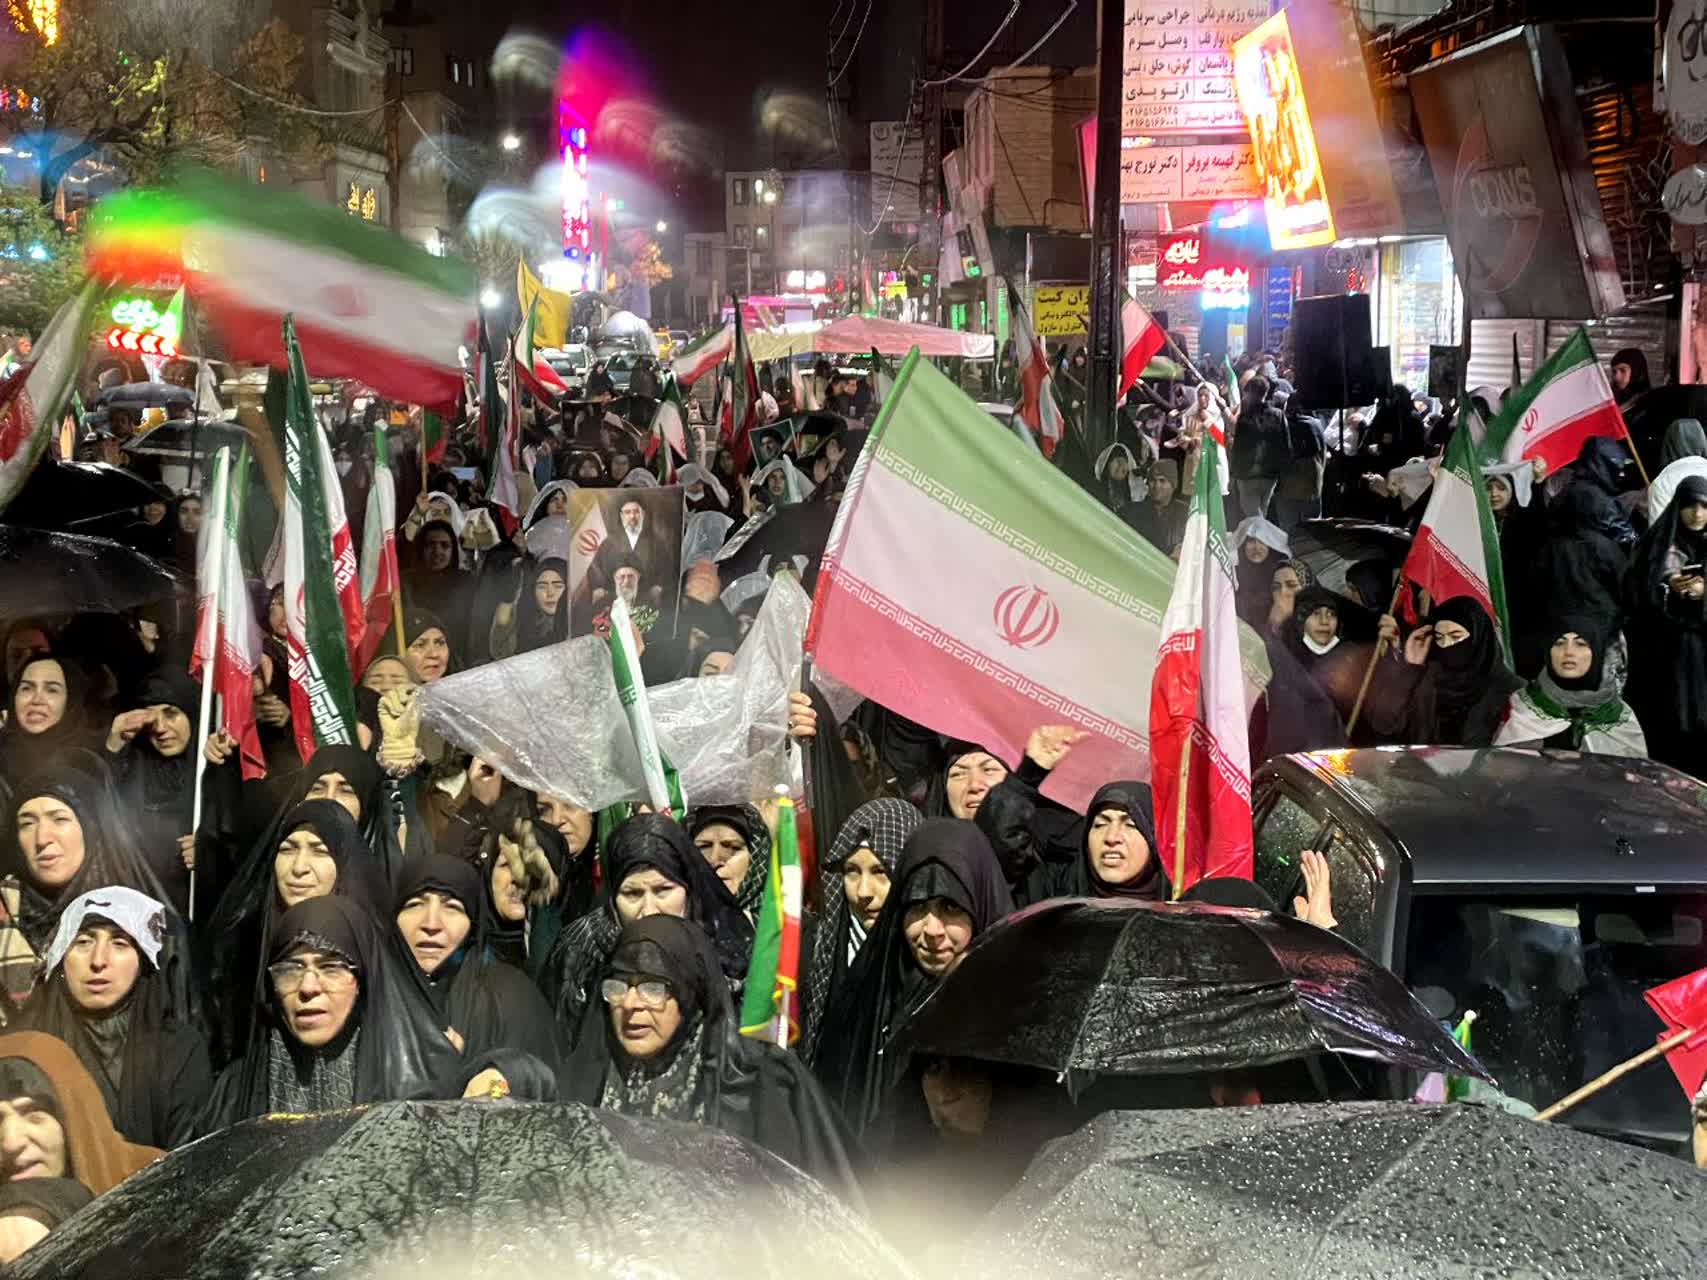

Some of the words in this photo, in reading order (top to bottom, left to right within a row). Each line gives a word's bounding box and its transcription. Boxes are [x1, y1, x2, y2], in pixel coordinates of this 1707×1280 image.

[1158, 8, 1190, 24] جراحی
[1129, 36, 1156, 50] سرم
[1158, 31, 1188, 48] وصل
[1159, 155, 1178, 174] دکتر
